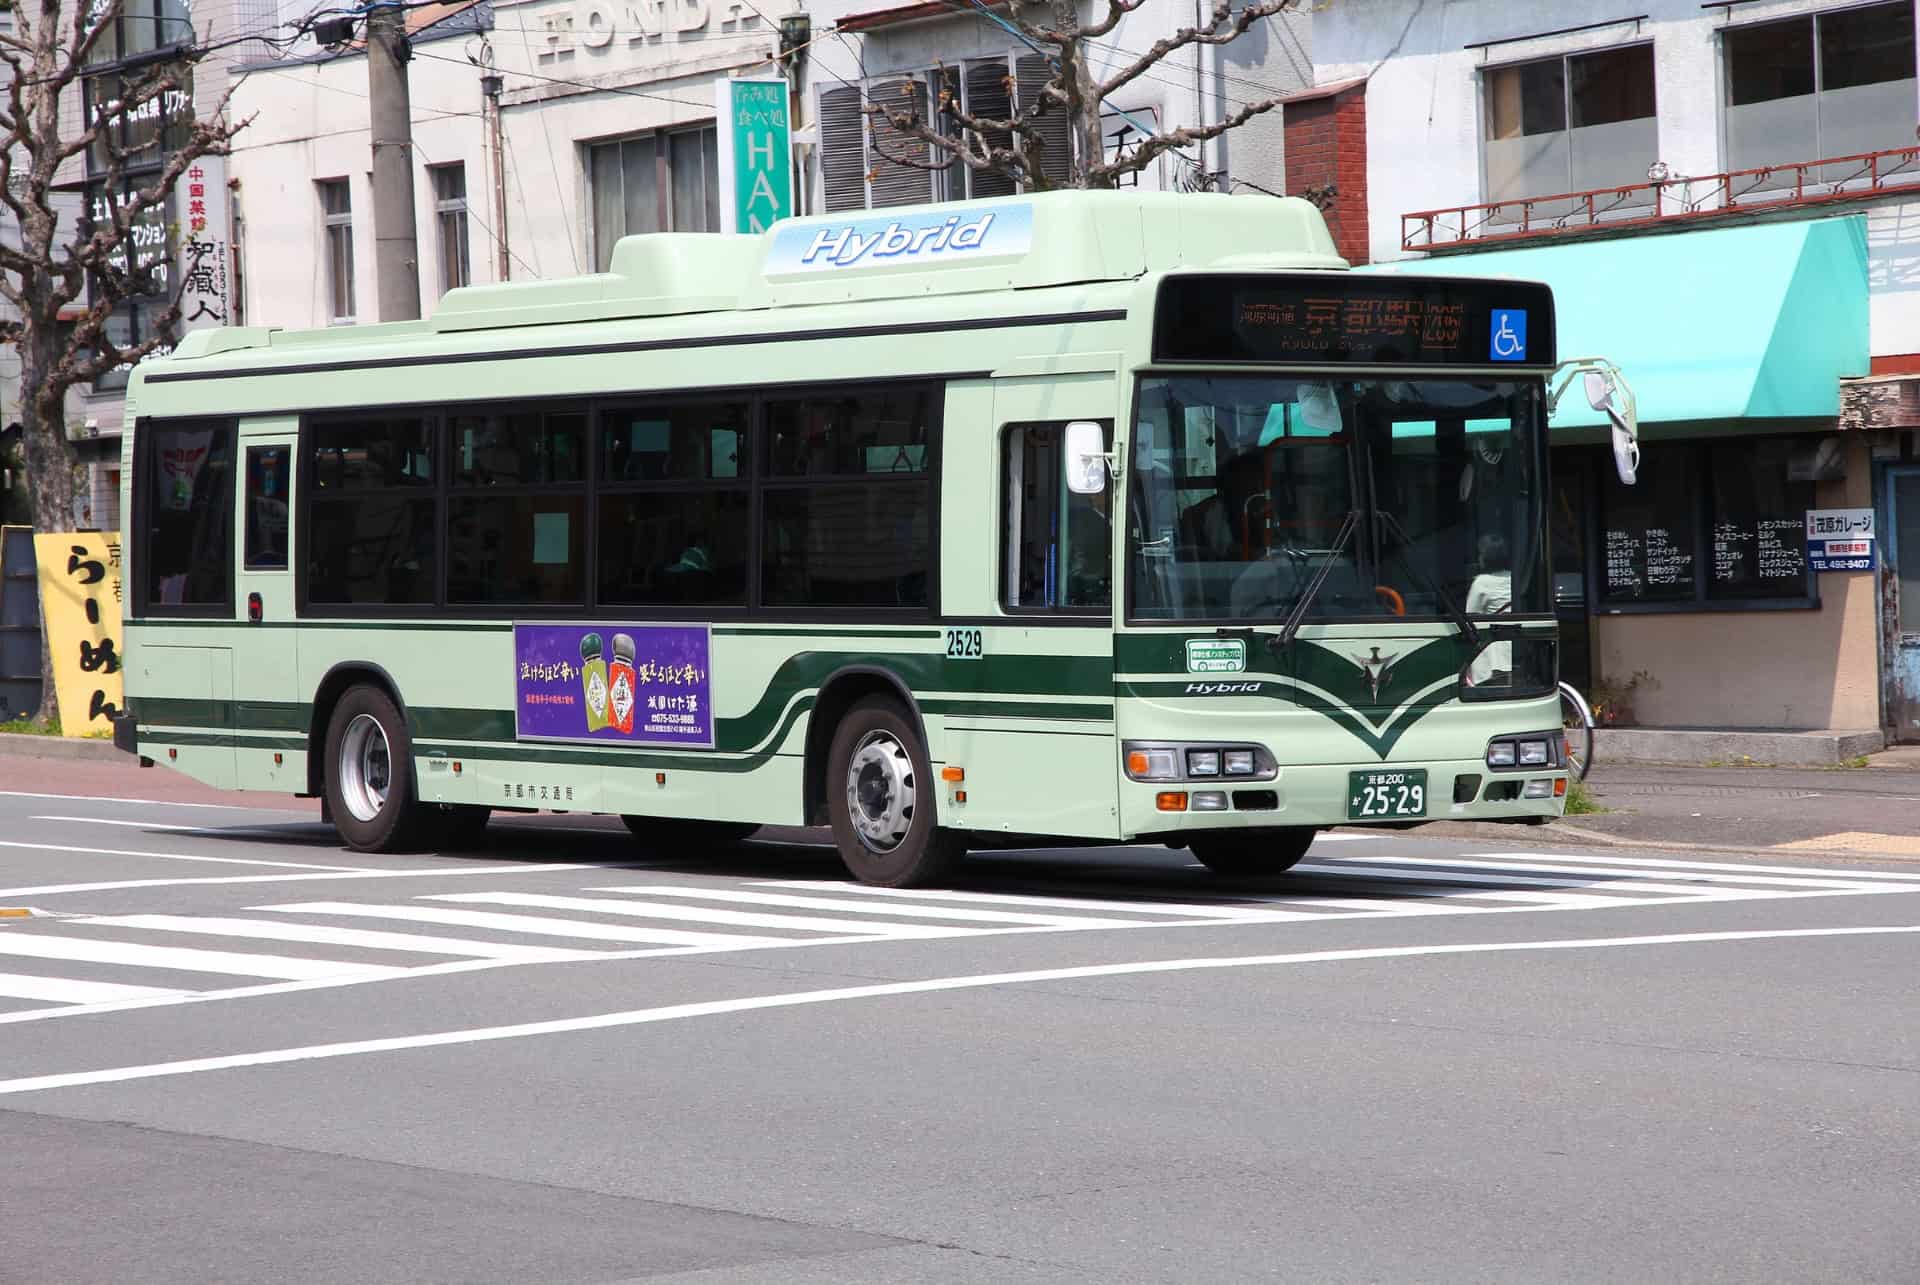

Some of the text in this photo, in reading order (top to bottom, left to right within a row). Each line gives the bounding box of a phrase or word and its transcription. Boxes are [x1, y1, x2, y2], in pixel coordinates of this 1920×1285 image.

[738, 107, 786, 128] 食べ処
[802, 213, 995, 267] Hybrid
[1812, 560, 1828, 569] TEL
[67, 545, 122, 722] らーめん
[947, 630, 982, 656] 2529
[520, 661, 579, 683] 泣けるほど辛い
[639, 659, 705, 686] 笑えるほど辛い
[1185, 682, 1262, 695] Hybrid
[504, 783, 574, 801] 京都市交通局
[1361, 785, 1423, 816] 25-29
